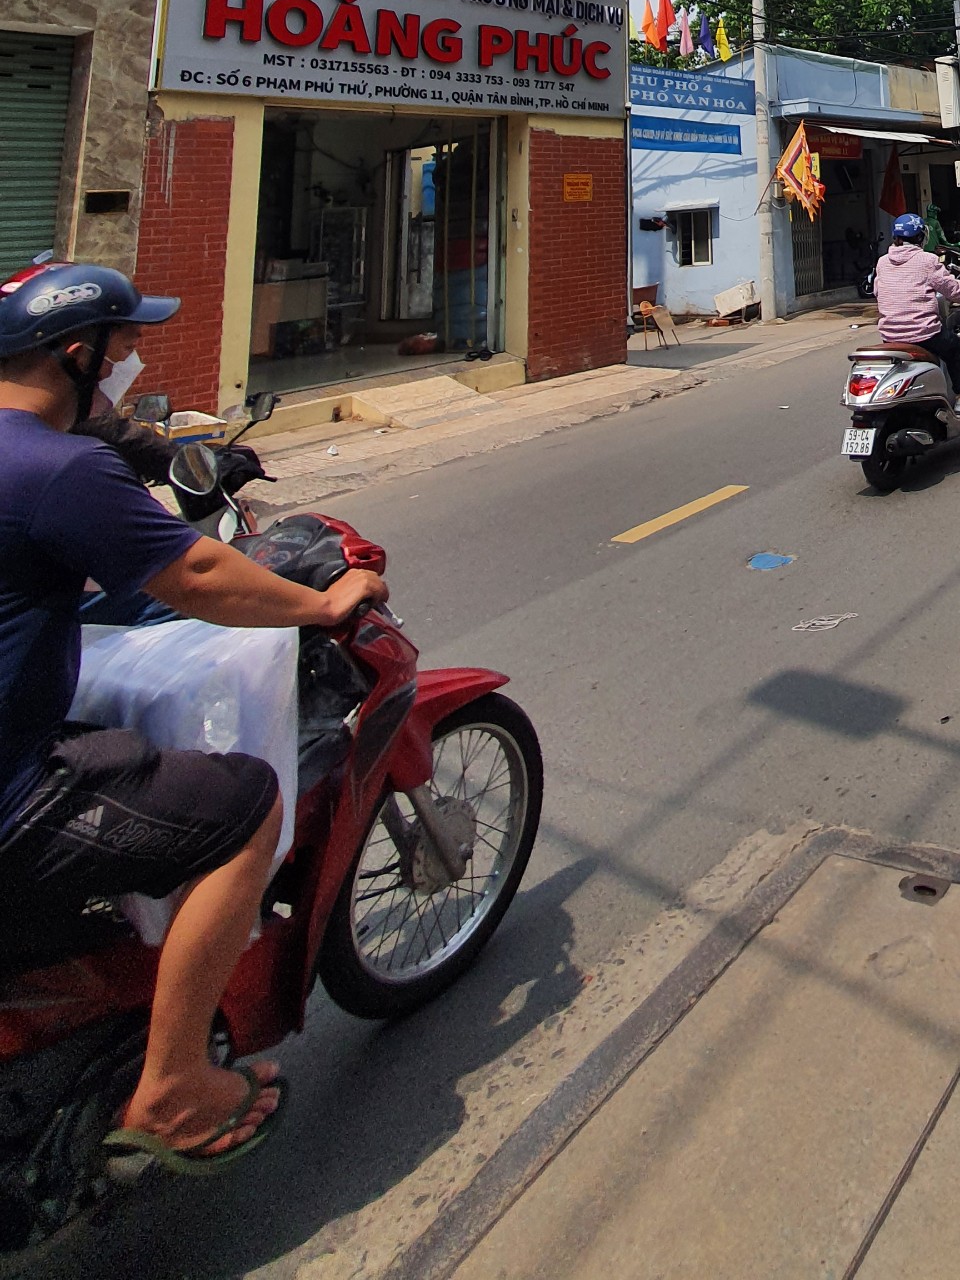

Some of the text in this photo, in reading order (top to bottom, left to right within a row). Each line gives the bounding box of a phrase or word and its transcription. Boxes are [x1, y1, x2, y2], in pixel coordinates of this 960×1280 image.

[575, 0, 604, 26] DỊCH
[606, 5, 625, 32] VỤ
[478, 22, 612, 80] PHÚC
[263, 53, 575, 93] MST 0317155563 ĐT 094 3333 753 093 7177 547
[631, 73, 658, 87] HU
[663, 78, 700, 91] PHỐ
[702, 84, 712, 93] 4
[216, 68, 241, 86] SỐ
[242, 75, 251, 87] 6
[256, 75, 301, 93] PHẠM
[304, 77, 335, 93] PHÚ
[374, 83, 428, 100] PHƯỜNG
[451, 89, 483, 108] QUẬN
[486, 91, 508, 104] TÂN
[555, 95, 569, 109] HỒ
[571, 99, 586, 110] CHÍ
[588, 102, 609, 112] MINH
[630, 89, 669, 102] PHỐ
[713, 96, 748, 110] HÓA
[845, 440, 870, 454] 152.86
[848, 428, 869, 441] 59-C4
